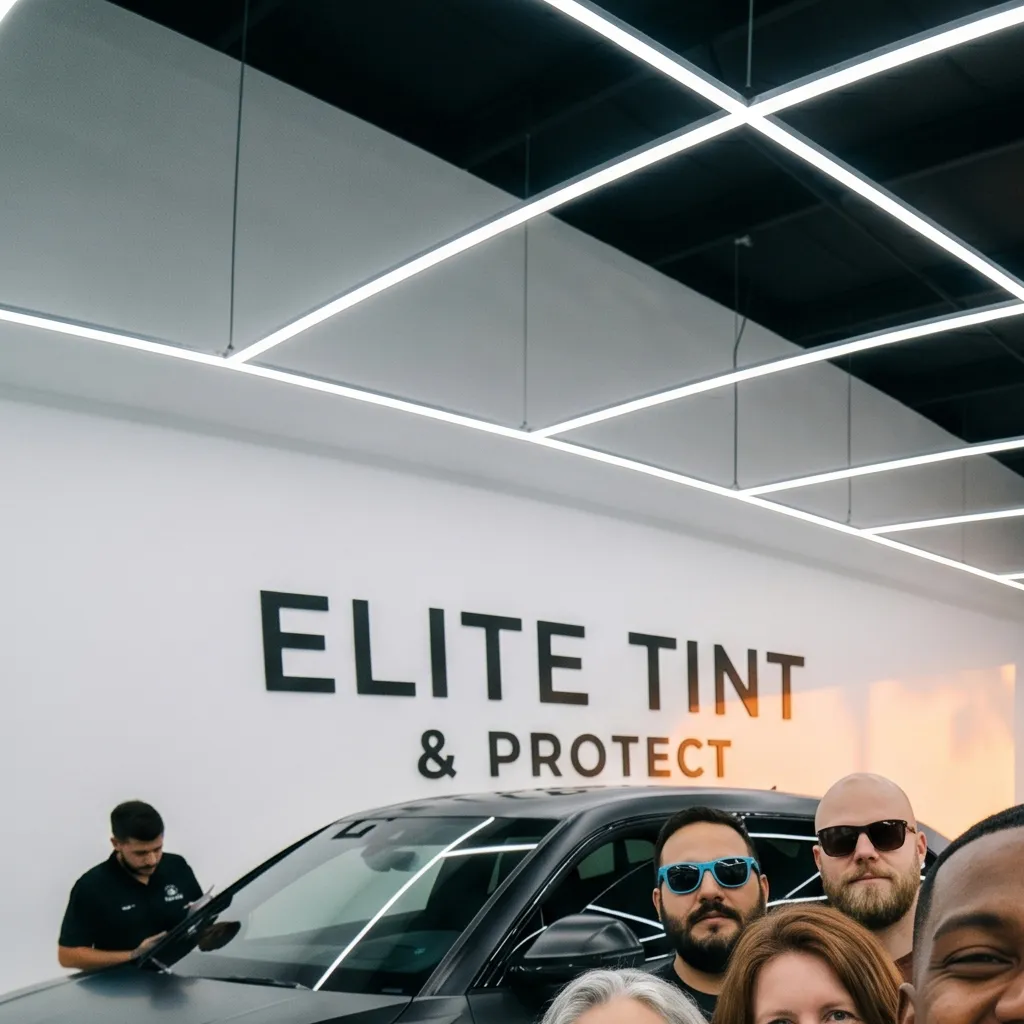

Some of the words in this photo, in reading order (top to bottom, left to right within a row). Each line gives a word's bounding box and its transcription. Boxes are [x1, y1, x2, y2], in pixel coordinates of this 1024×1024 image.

[260, 590, 589, 706] ELITE
[629, 632, 805, 720] TINT
[418, 730, 457, 779] &
[488, 731, 732, 778] PROTECT
